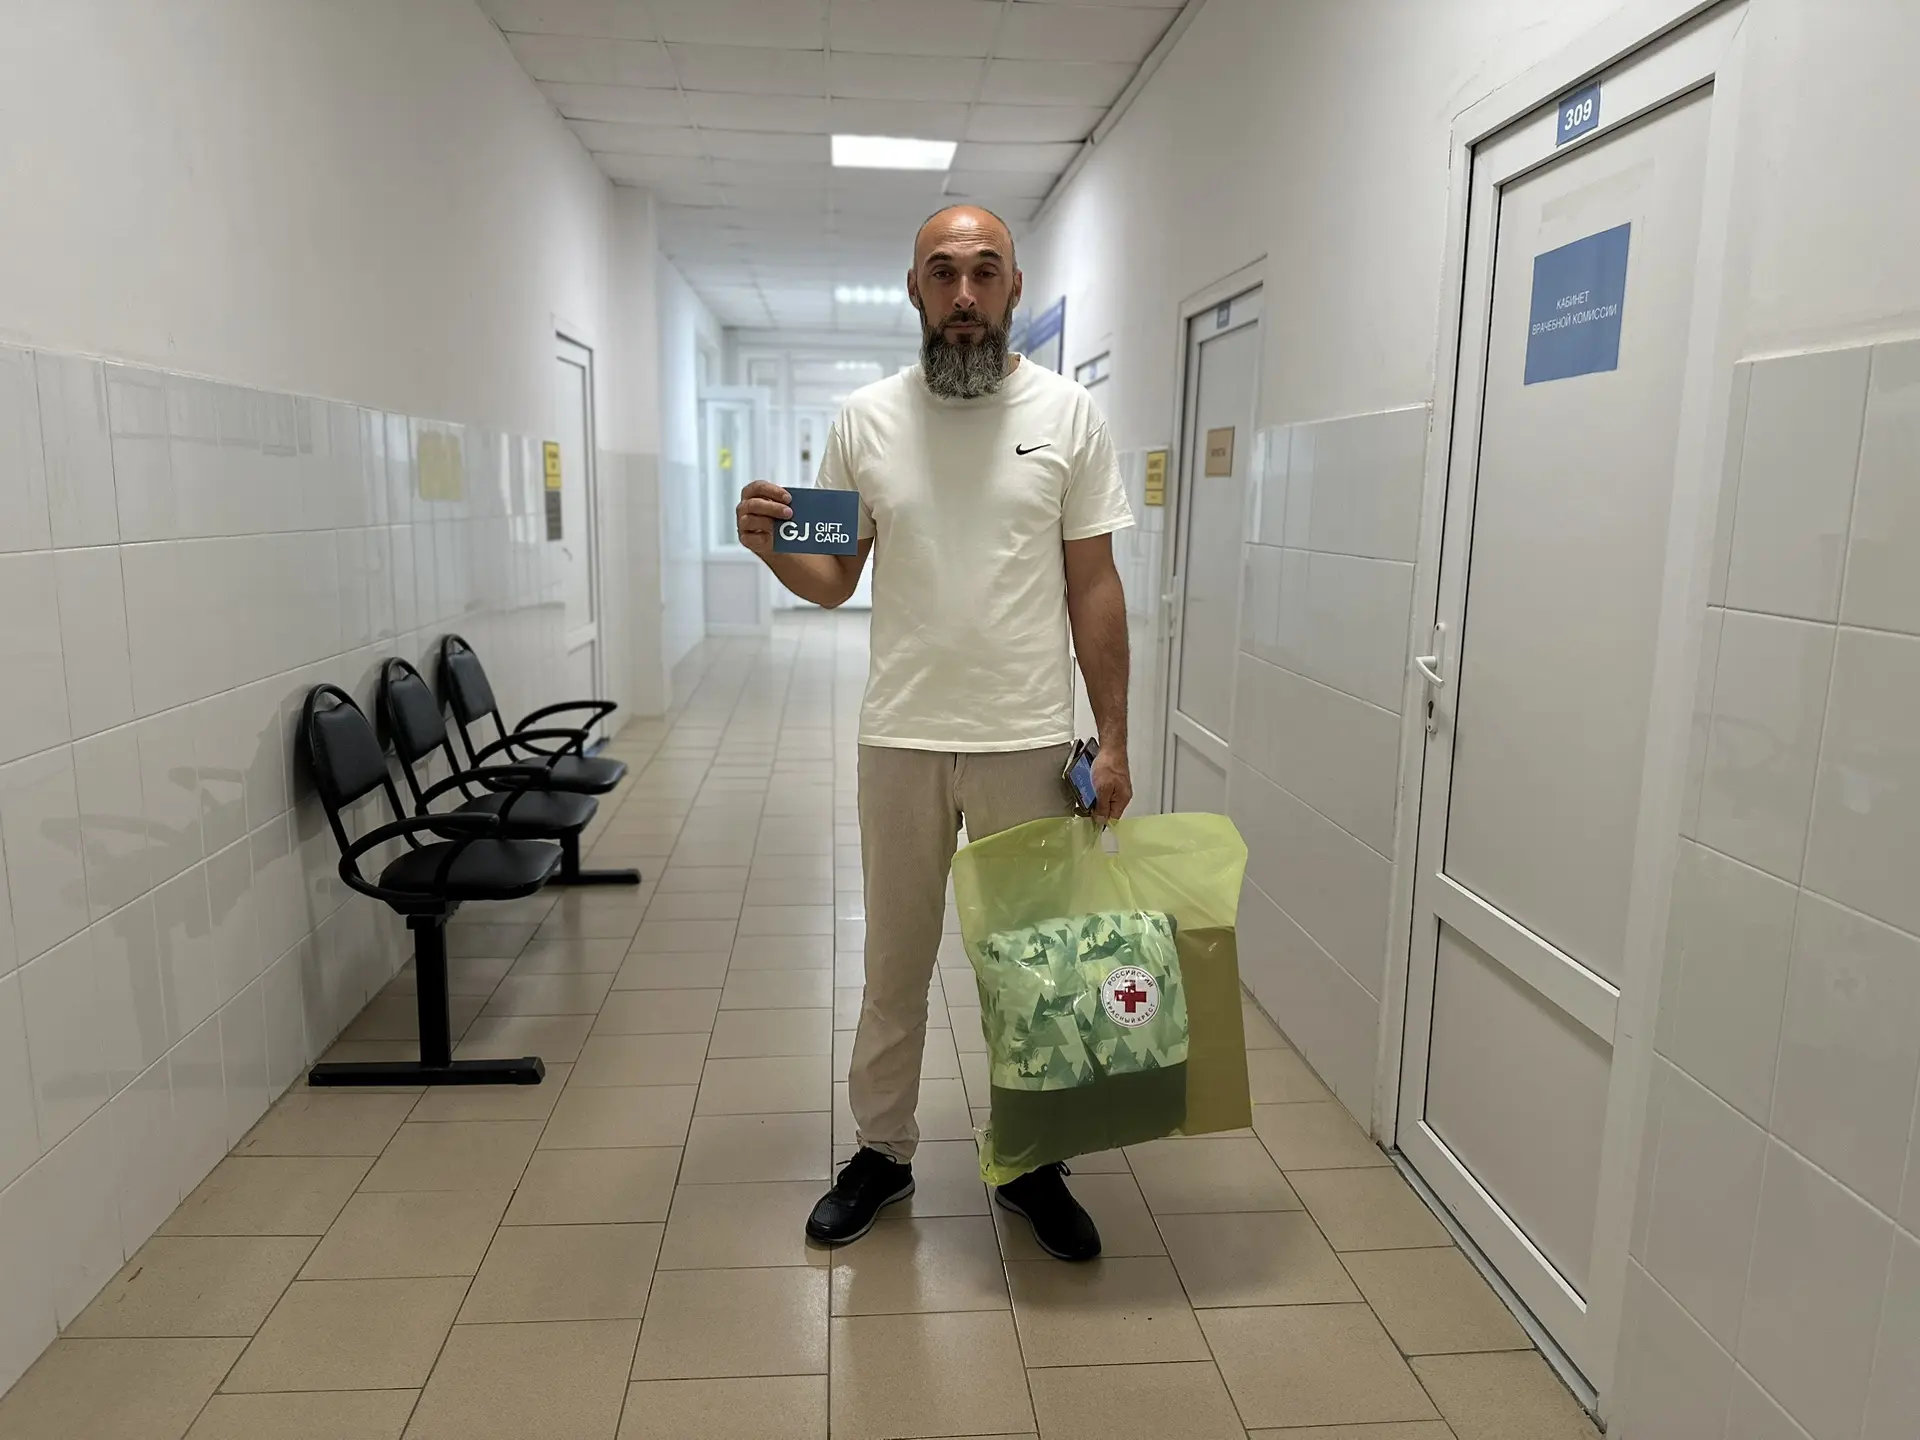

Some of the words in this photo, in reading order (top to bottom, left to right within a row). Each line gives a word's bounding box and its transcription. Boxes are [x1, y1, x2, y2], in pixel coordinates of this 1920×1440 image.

[1564, 98, 1593, 131] 309
[1555, 290, 1590, 310] КАБИНЕТ
[1531, 313, 1571, 336] ВРАЧЕБНОЙ
[1572, 303, 1618, 325] КОМИССИИ
[779, 521, 810, 542] GJ
[815, 522, 843, 533] GIFT
[815, 533, 850, 543] CARD
[1137, 1003, 1155, 1022] КРЕСТ
